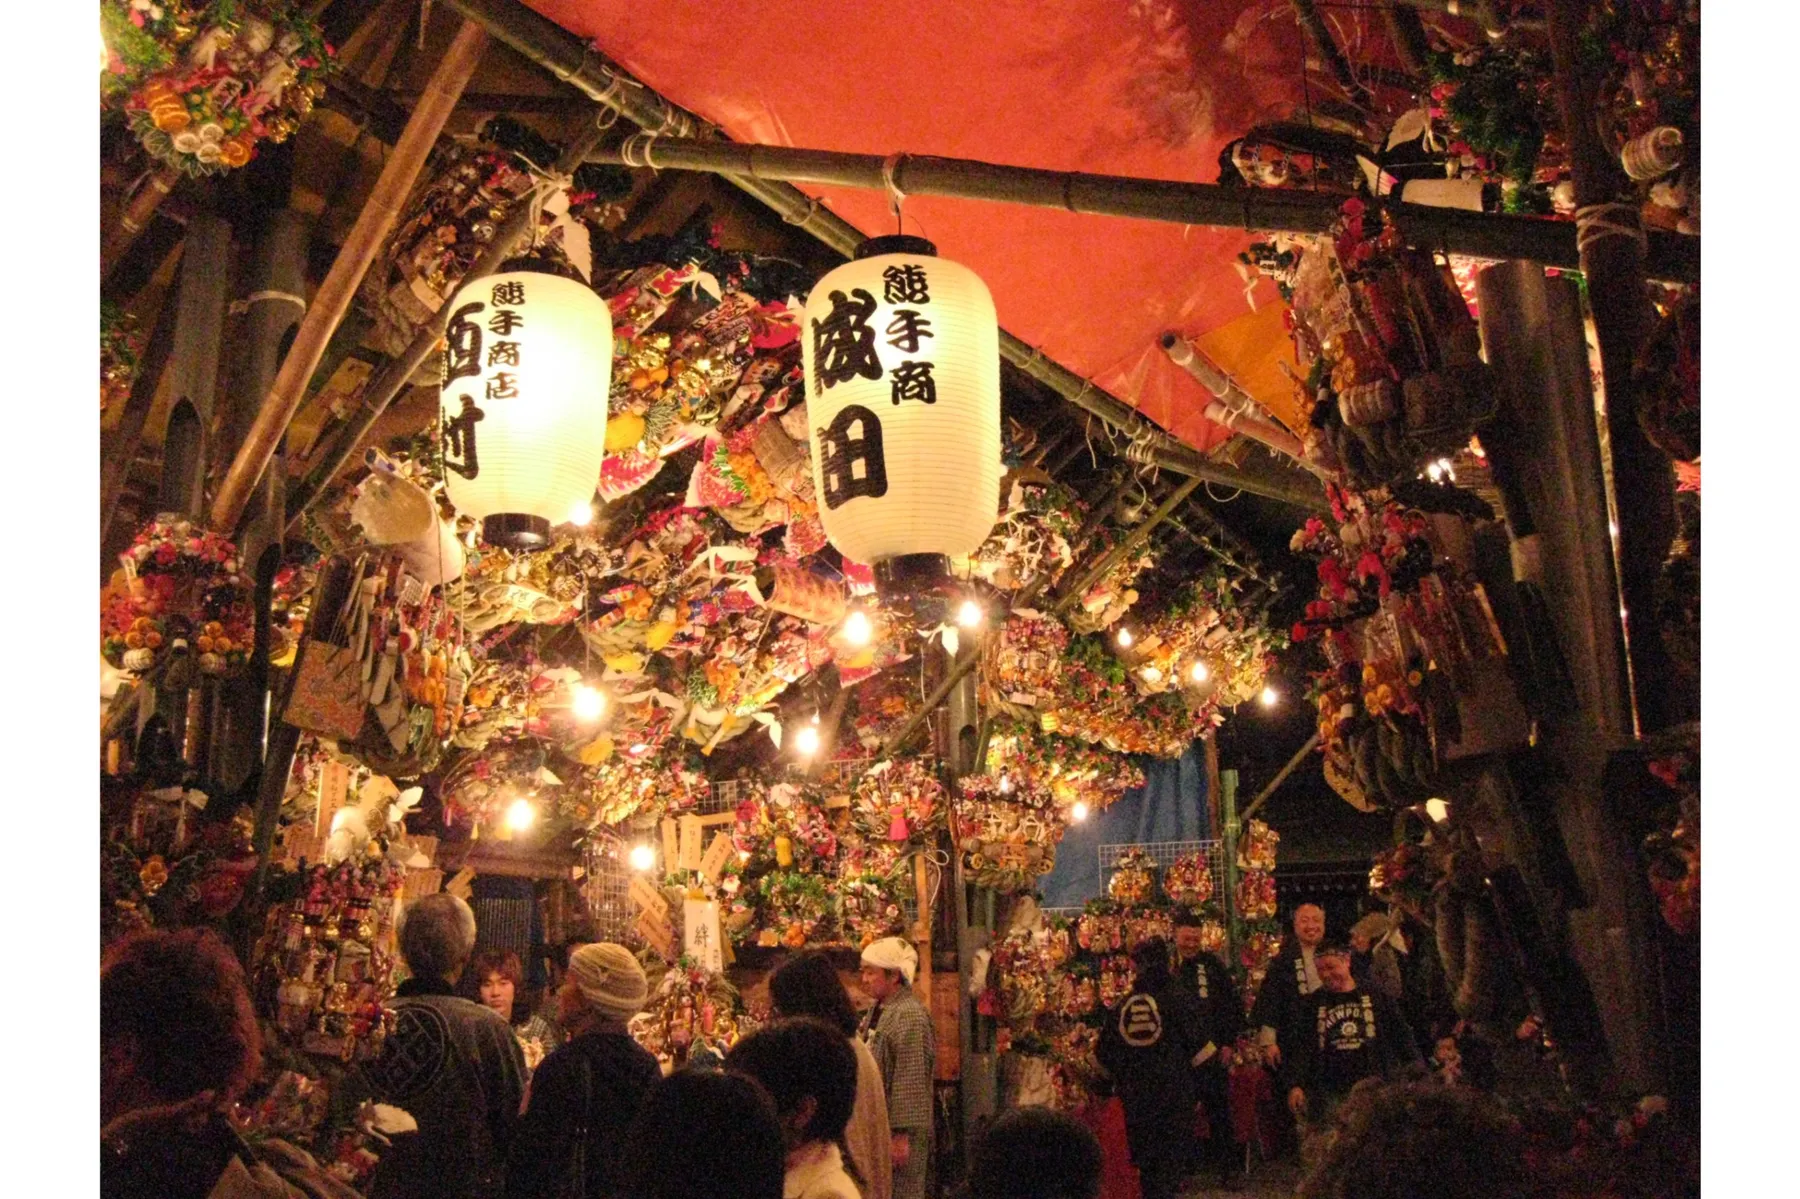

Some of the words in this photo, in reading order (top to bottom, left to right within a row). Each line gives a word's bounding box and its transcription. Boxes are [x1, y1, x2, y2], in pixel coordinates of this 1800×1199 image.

[485, 281, 526, 400] 熊手商店
[883, 264, 937, 405] 熊手商
